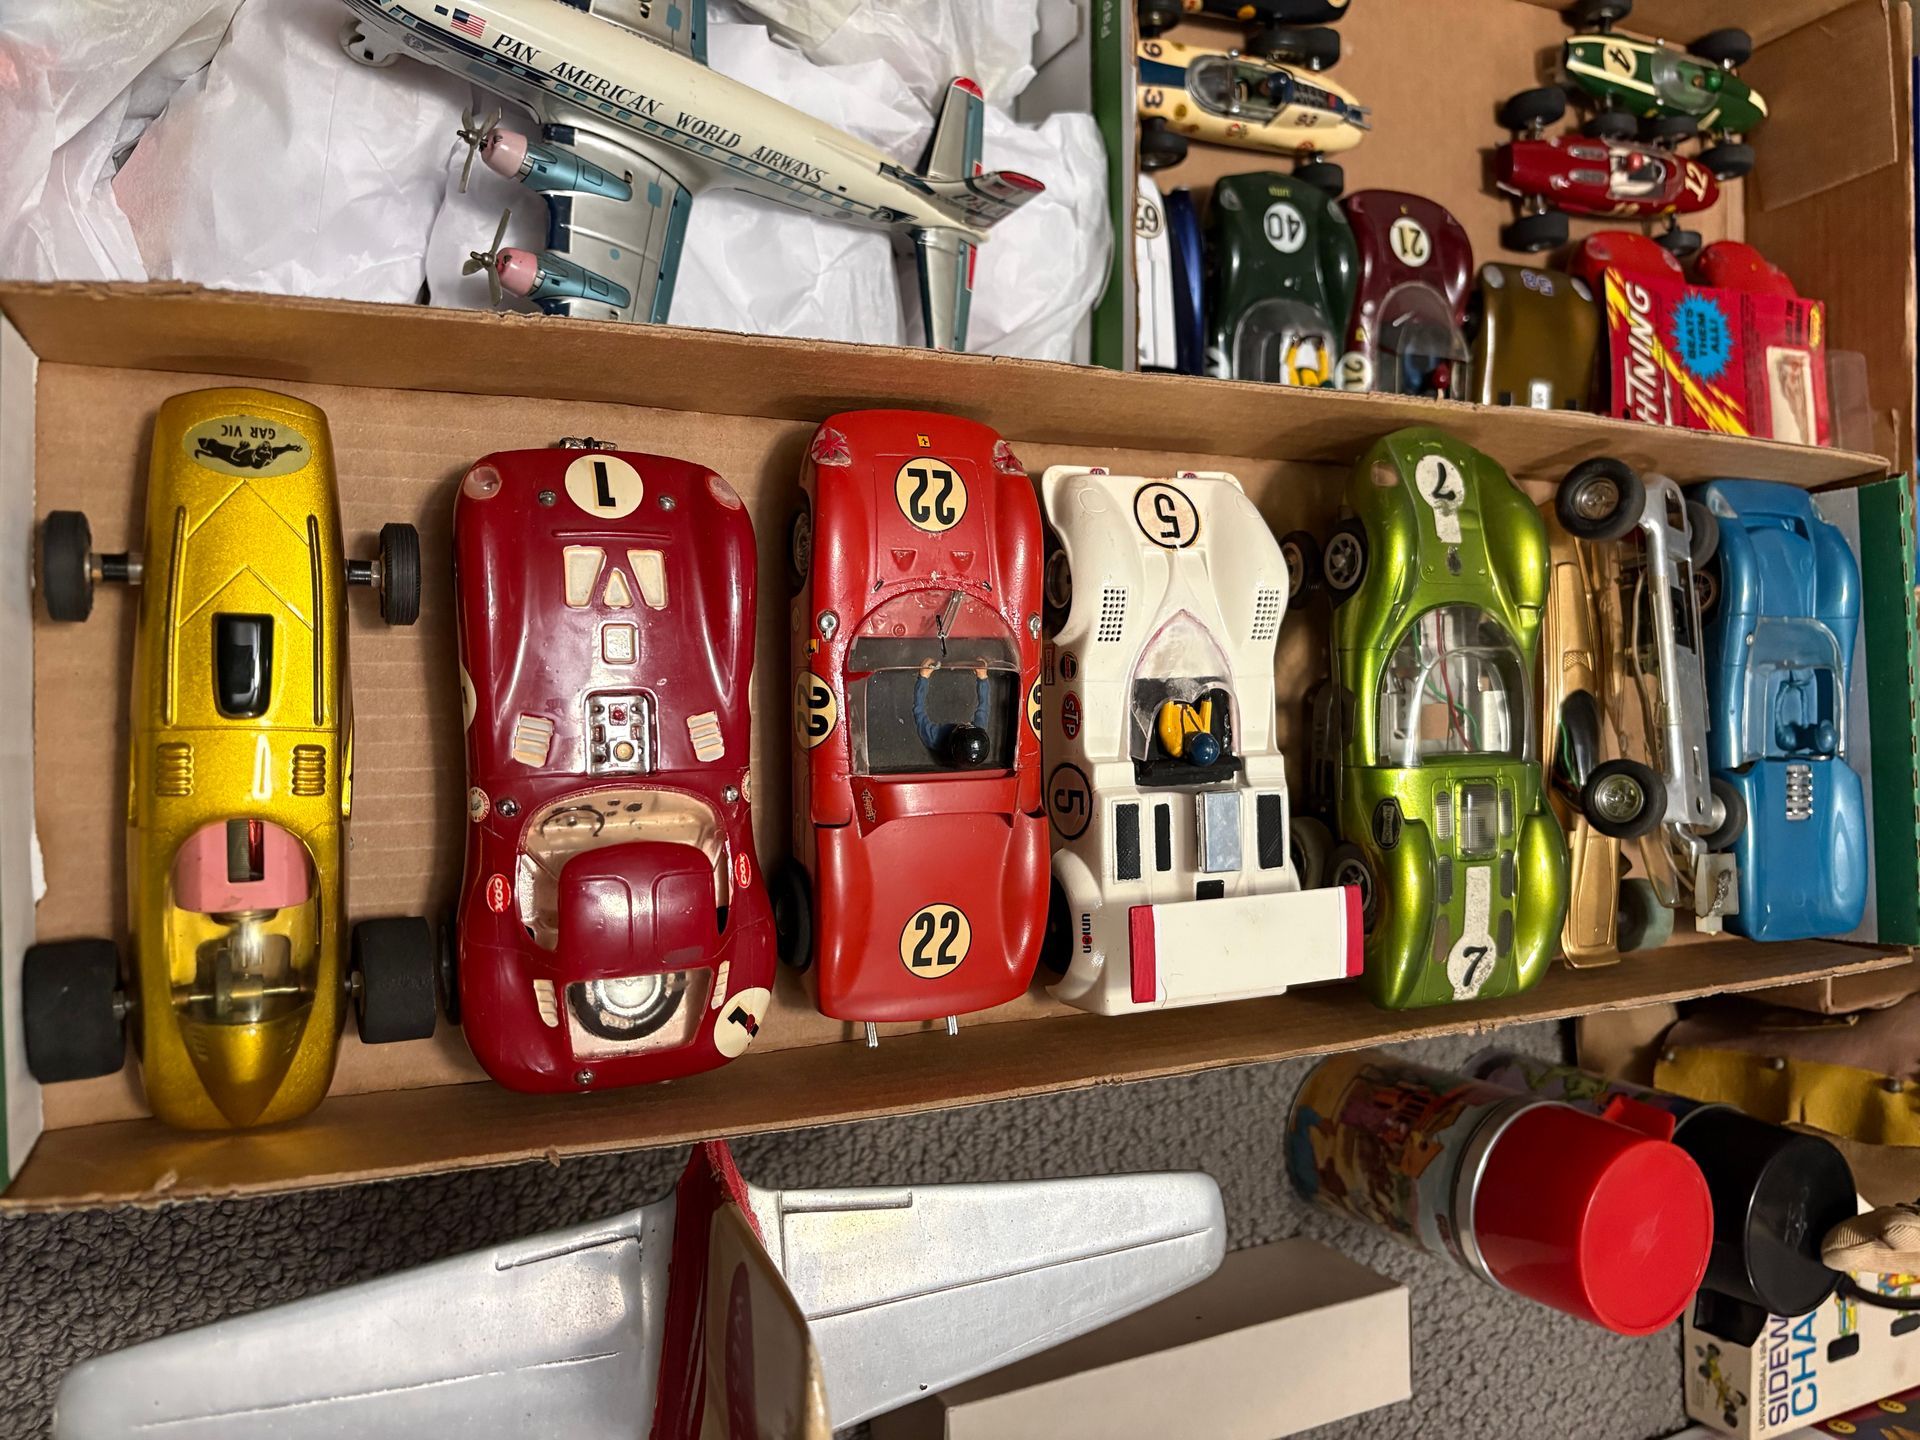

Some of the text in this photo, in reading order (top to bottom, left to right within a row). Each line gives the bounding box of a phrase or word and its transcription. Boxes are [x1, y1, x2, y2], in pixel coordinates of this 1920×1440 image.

[1607, 48, 1631, 72] 4
[492, 33, 829, 184] PAN AMERICAN WORLD AIRWAYS
[1685, 162, 1709, 202] 12
[1266, 212, 1301, 243] 40
[1400, 227, 1424, 258] 21
[1686, 307, 1697, 360] BEATS
[1699, 312, 1709, 357] THEM
[220, 424, 276, 440] GAR VIC
[593, 461, 616, 507] 1
[907, 468, 955, 525] 22
[1431, 462, 1456, 501] 7
[1154, 493, 1181, 539] 5
[797, 683, 830, 737] 22
[1063, 699, 1079, 736] STP
[1054, 788, 1085, 816] 5
[739, 853, 747, 885] COX
[494, 877, 504, 912] COX
[912, 910, 960, 968] 22
[1462, 946, 1488, 987] 7
[1768, 1317, 1789, 1427] SIDEW
[1791, 1312, 1817, 1417] CHA
